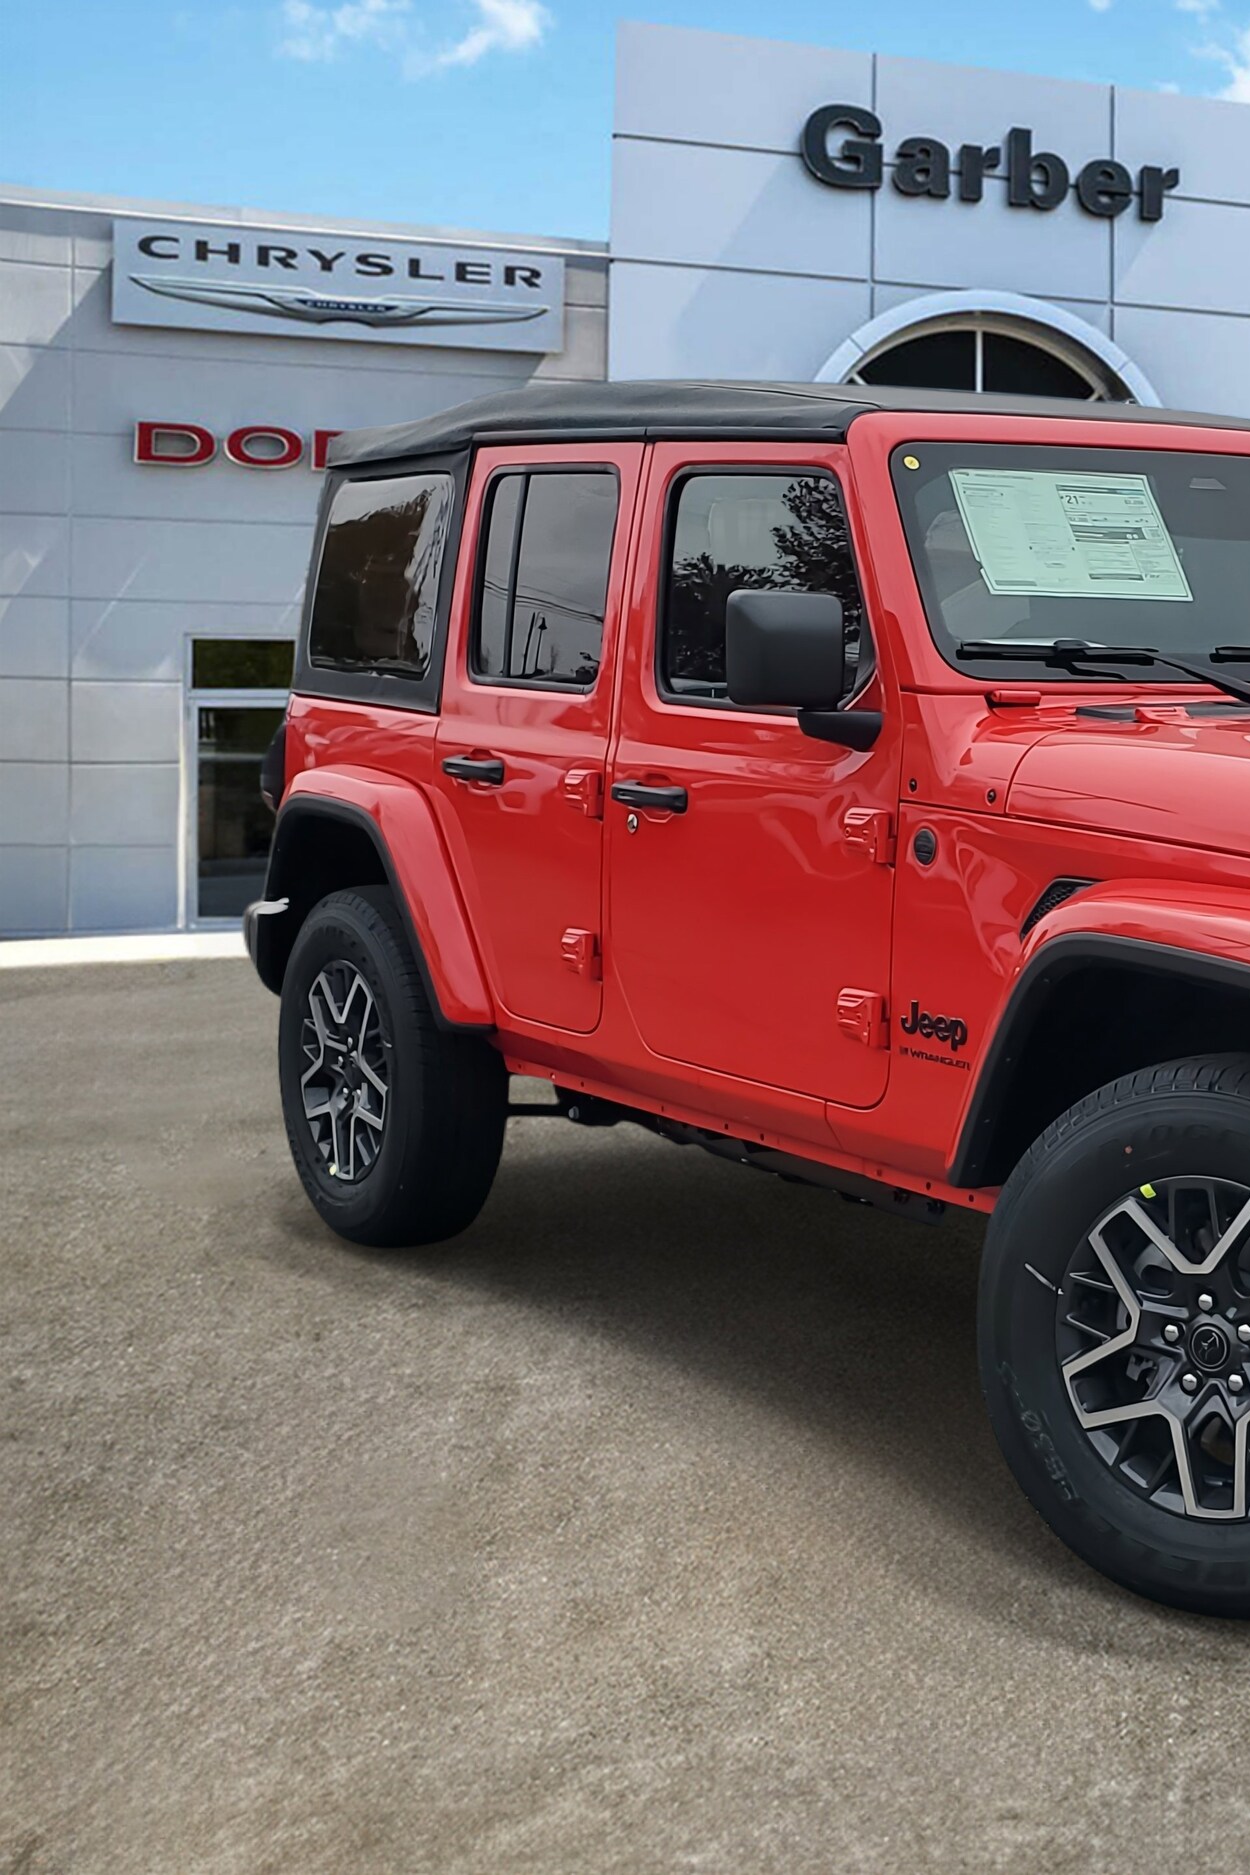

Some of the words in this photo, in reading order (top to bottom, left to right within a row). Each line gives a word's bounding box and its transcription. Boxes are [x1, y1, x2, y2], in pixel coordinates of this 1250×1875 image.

[803, 104, 1180, 222] Garber
[138, 235, 543, 288] CHRYSLER
[901, 1000, 968, 1052] Jeep
